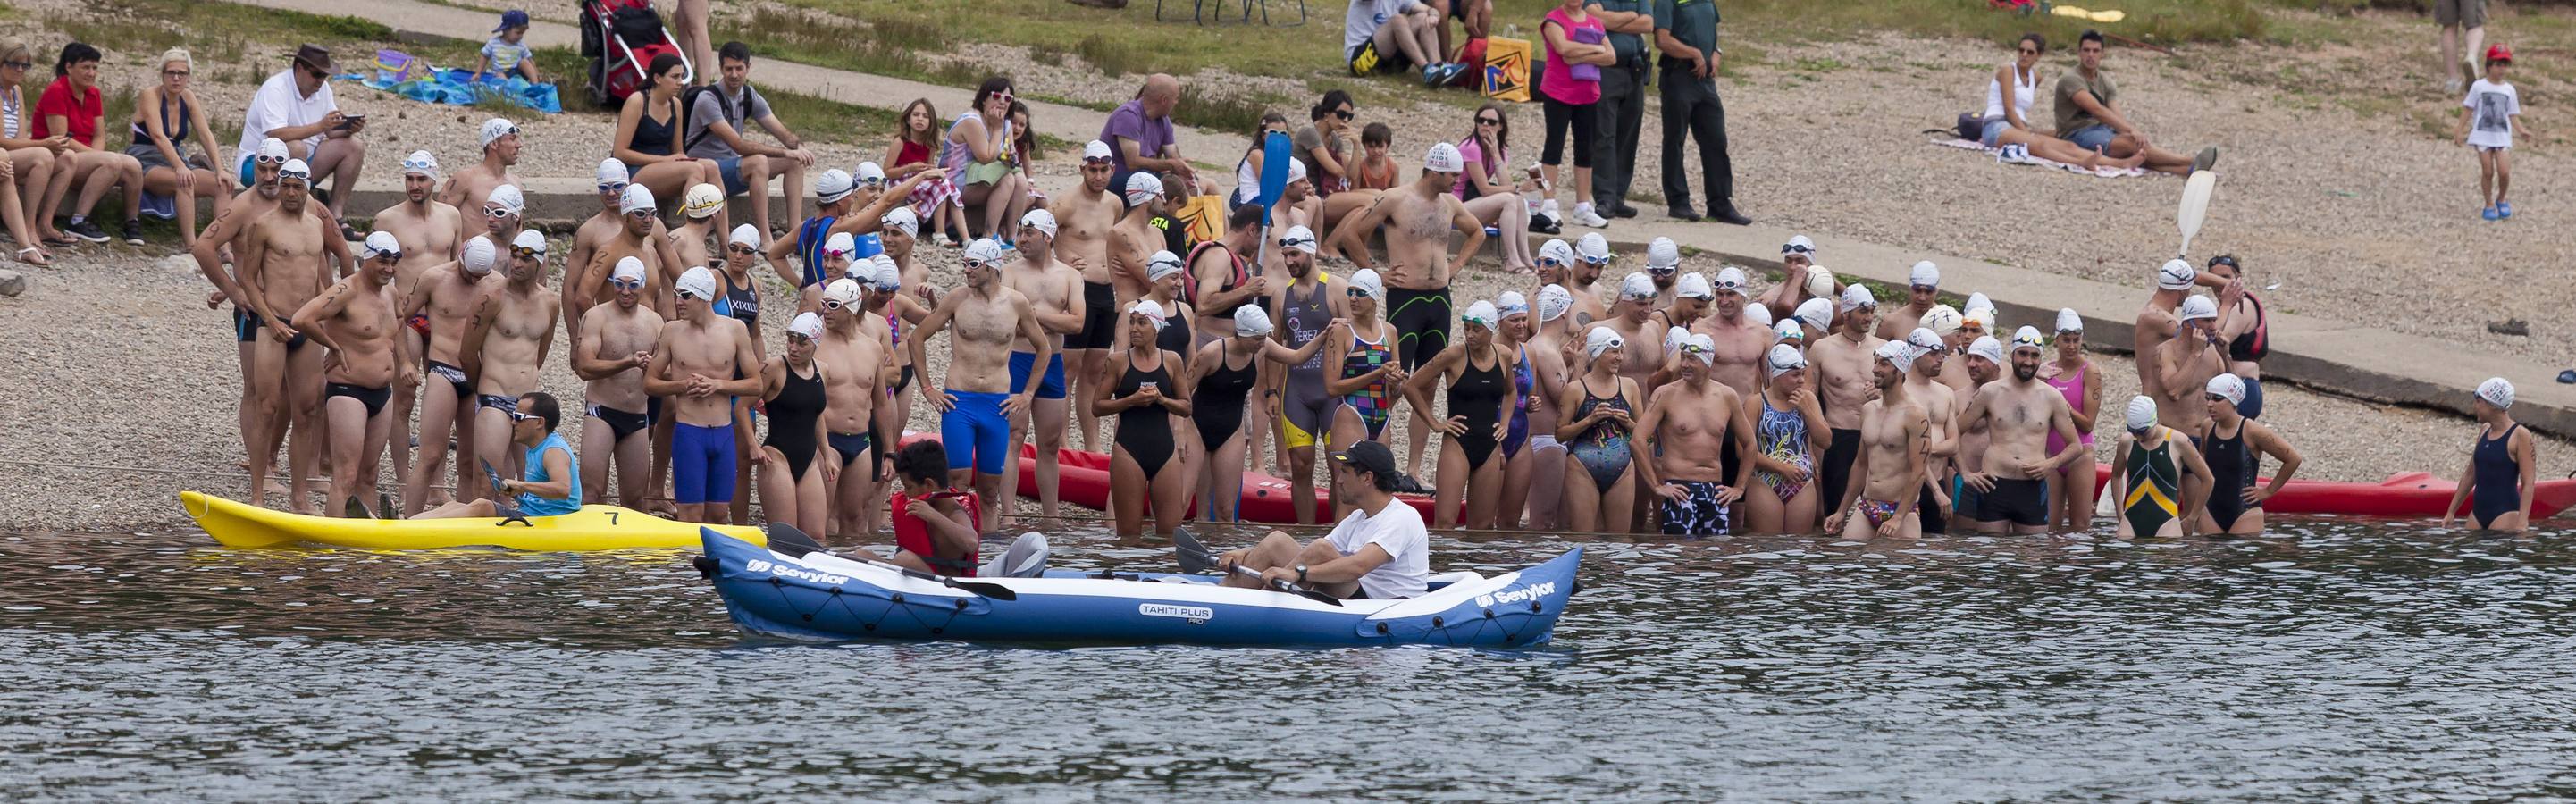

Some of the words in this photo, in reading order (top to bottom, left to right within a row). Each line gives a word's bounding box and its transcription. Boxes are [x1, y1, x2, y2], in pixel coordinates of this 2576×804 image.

[1294, 329, 1318, 342] PÉREZ
[604, 511, 618, 525] 7
[1494, 581, 1556, 604] Sevylor
[1143, 605, 1177, 616] TAHITI
[1180, 607, 1209, 618] PLUS
